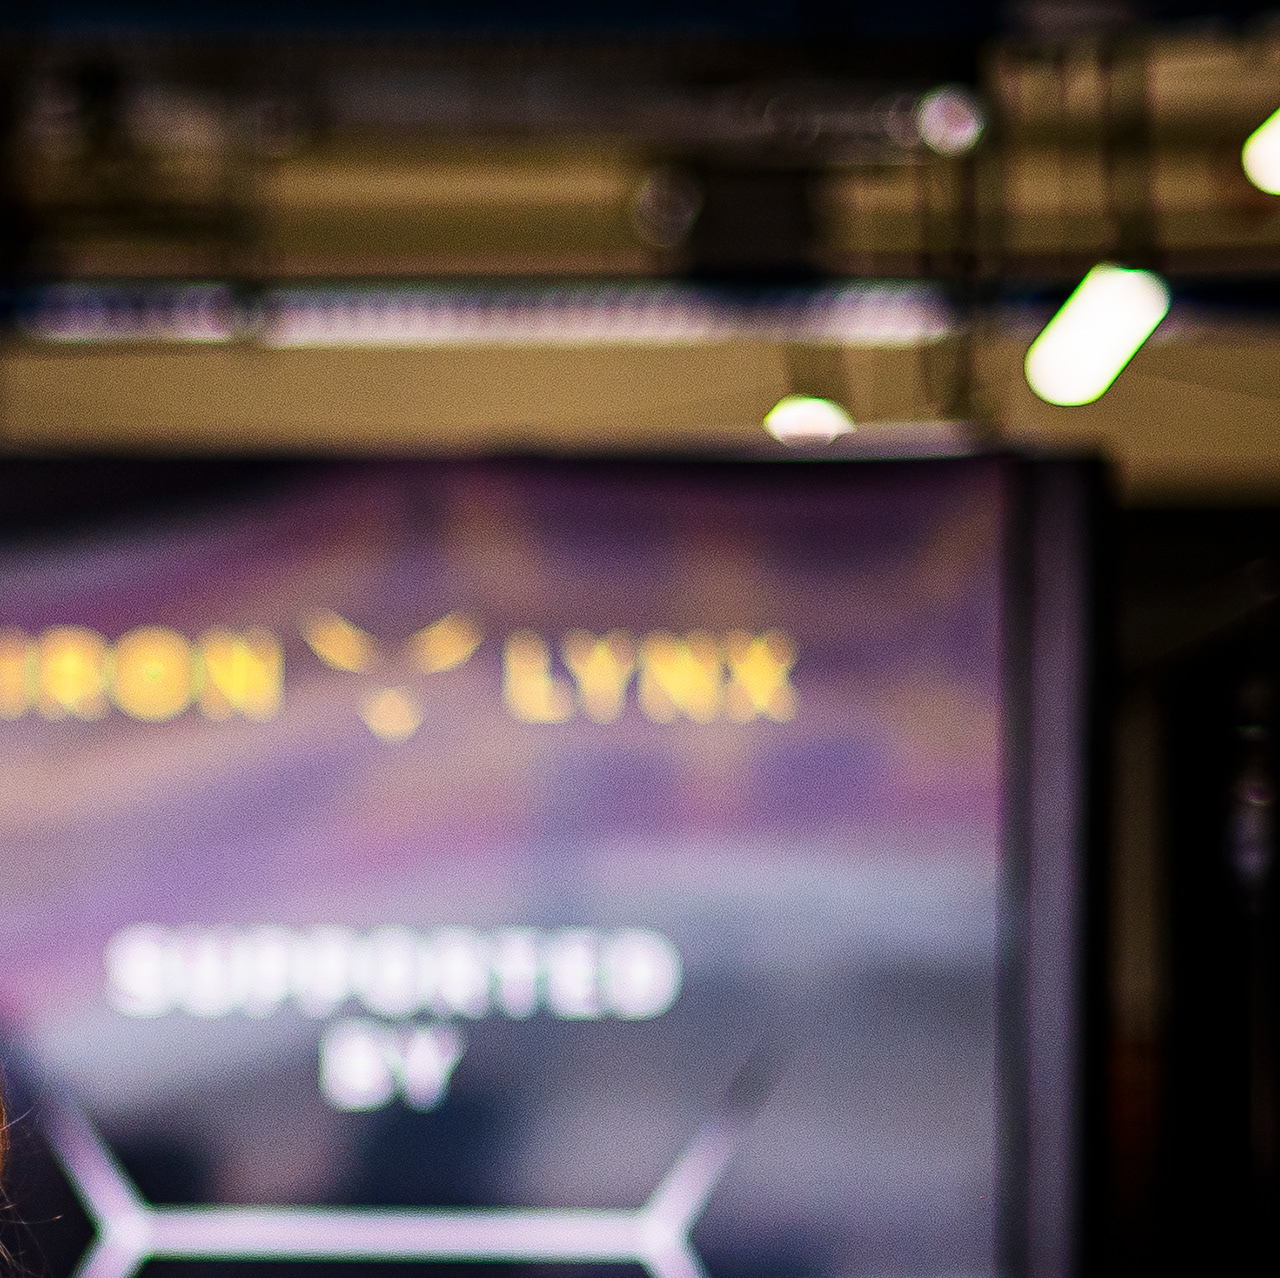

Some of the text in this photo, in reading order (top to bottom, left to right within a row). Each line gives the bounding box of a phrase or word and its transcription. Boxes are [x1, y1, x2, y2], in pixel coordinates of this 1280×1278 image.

[503, 627, 800, 724] LYNX
[106, 922, 682, 1021] SUPPORTED
[319, 1016, 466, 1113] BY
